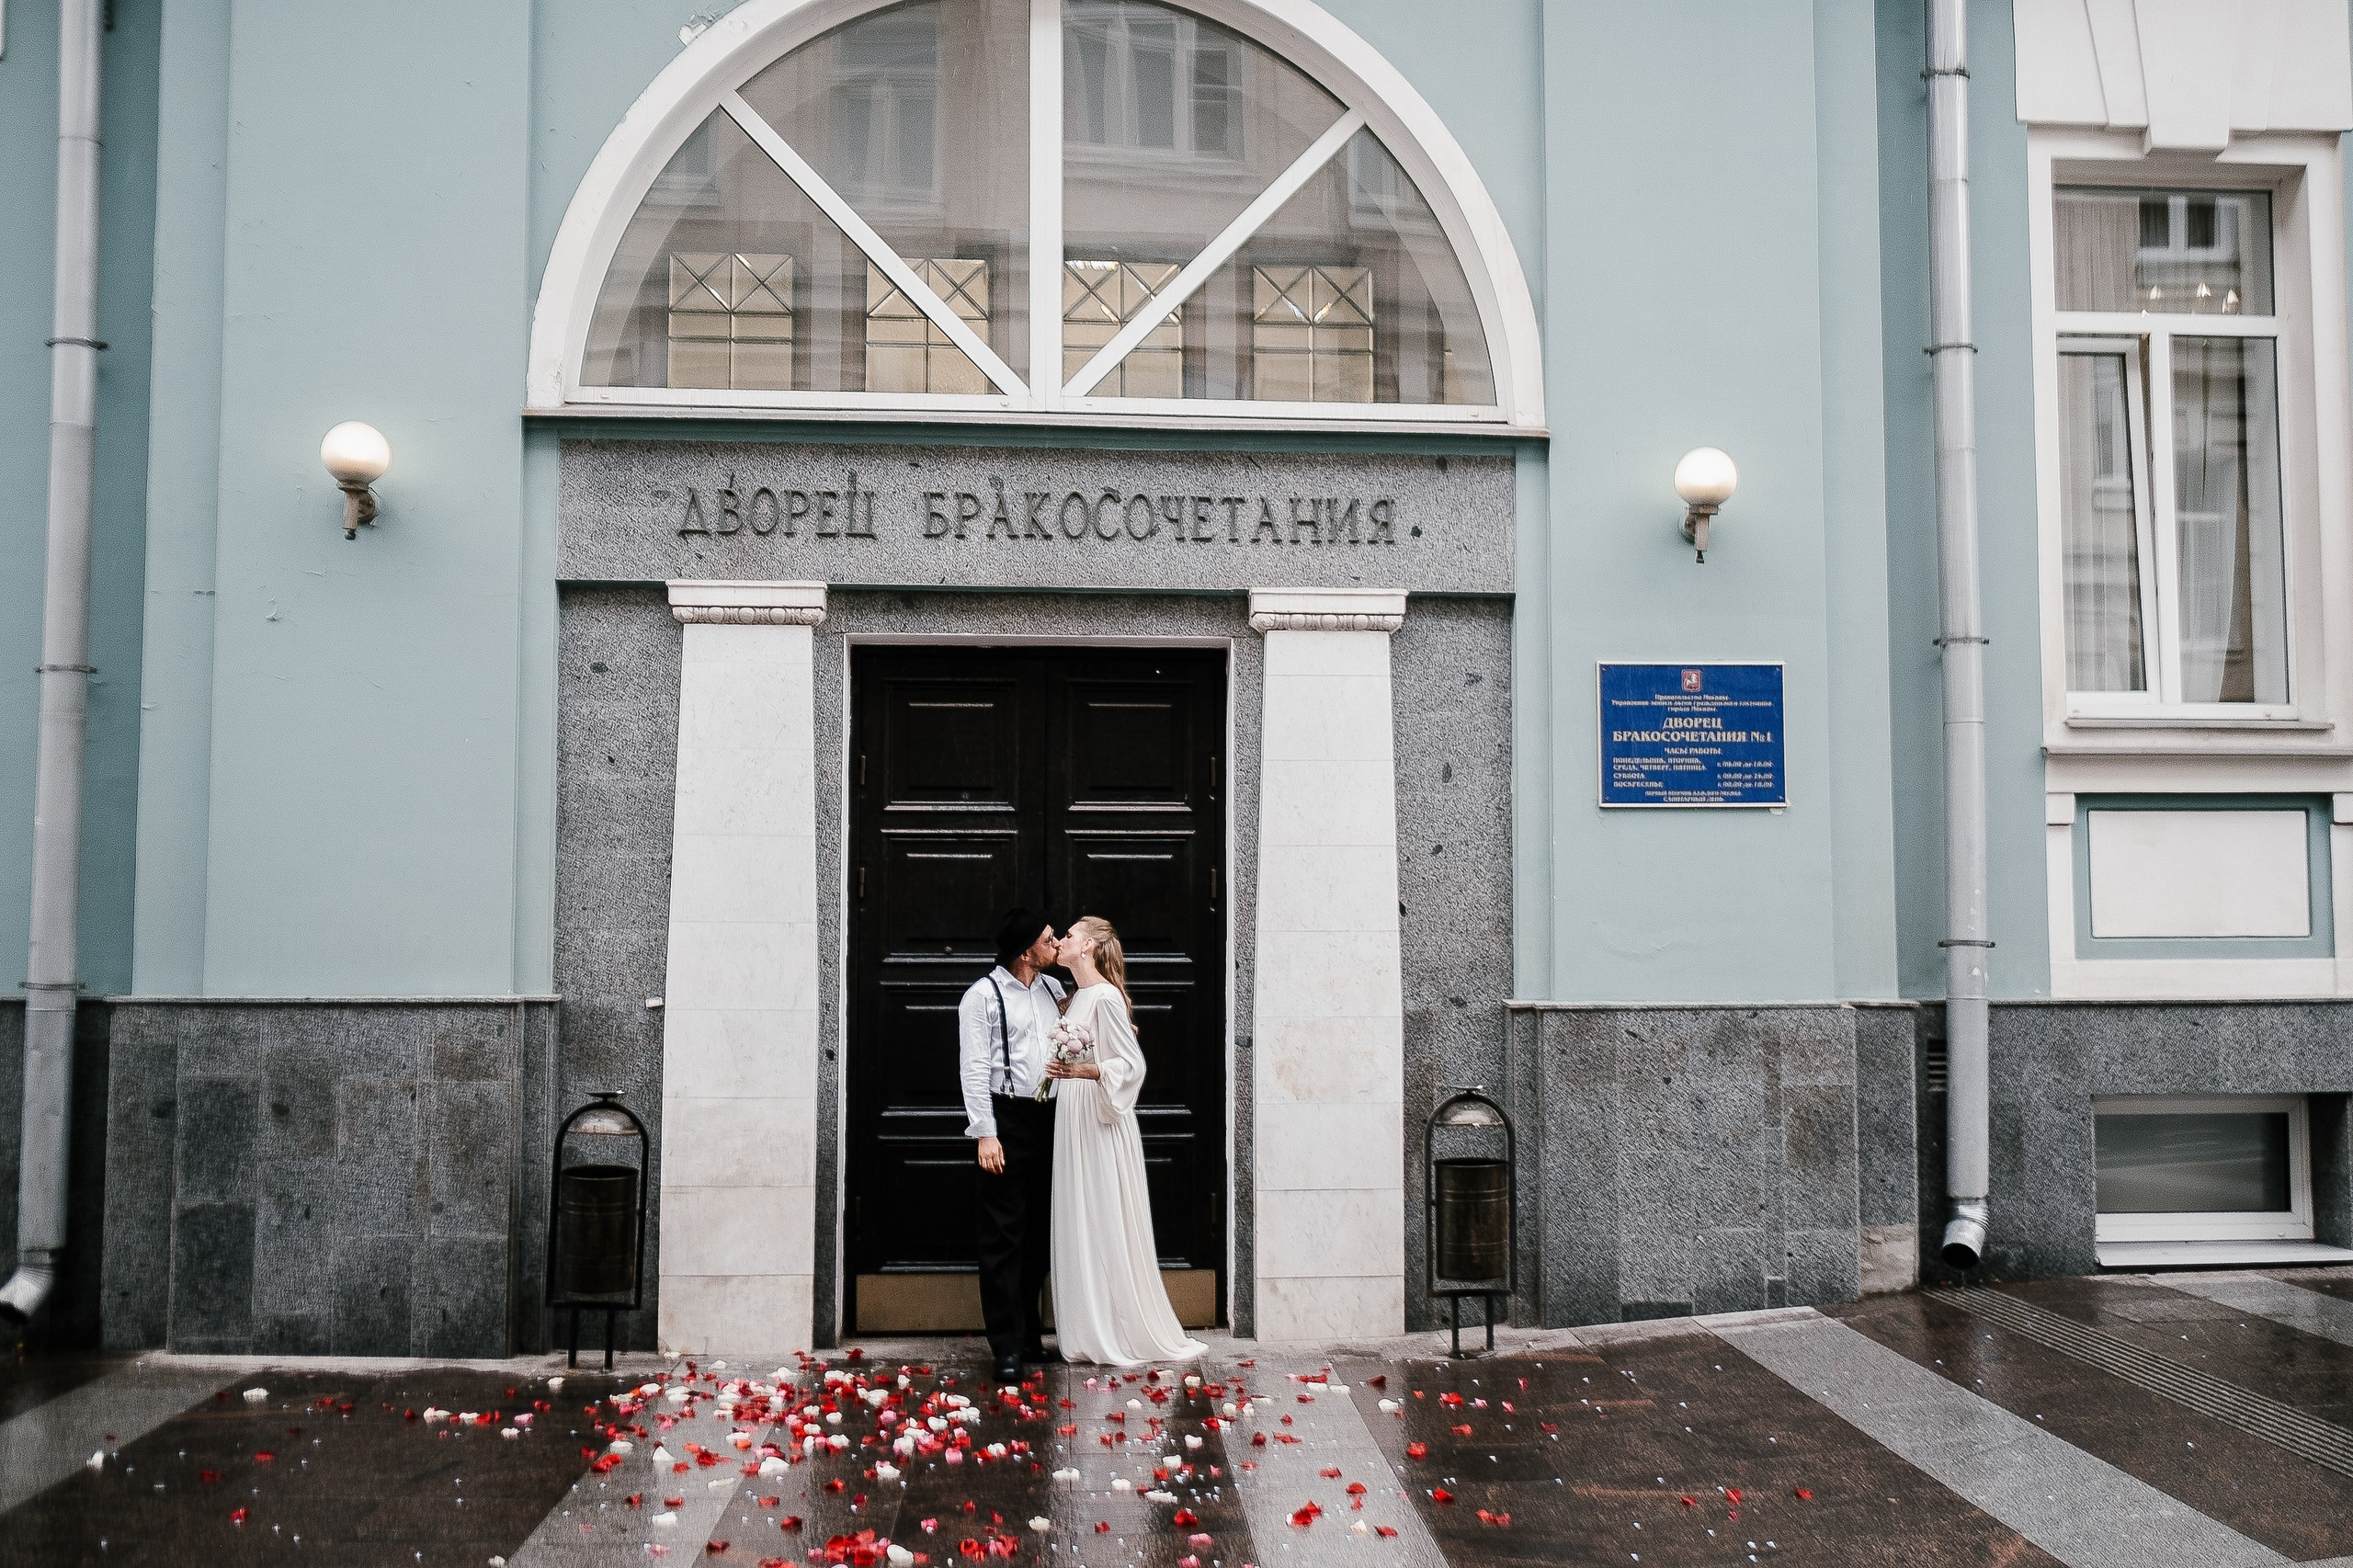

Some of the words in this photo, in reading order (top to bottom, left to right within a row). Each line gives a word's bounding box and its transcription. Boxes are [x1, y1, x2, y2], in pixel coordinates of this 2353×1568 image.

[678, 483, 876, 540] ДВОРЕЦ
[922, 488, 1397, 546] БРАКОСОЧЕТАНИЯ
[1663, 717, 1723, 729] ДВОРЕЦ
[1613, 731, 1746, 743] БРАКОСОЧЕТАНИЯ
